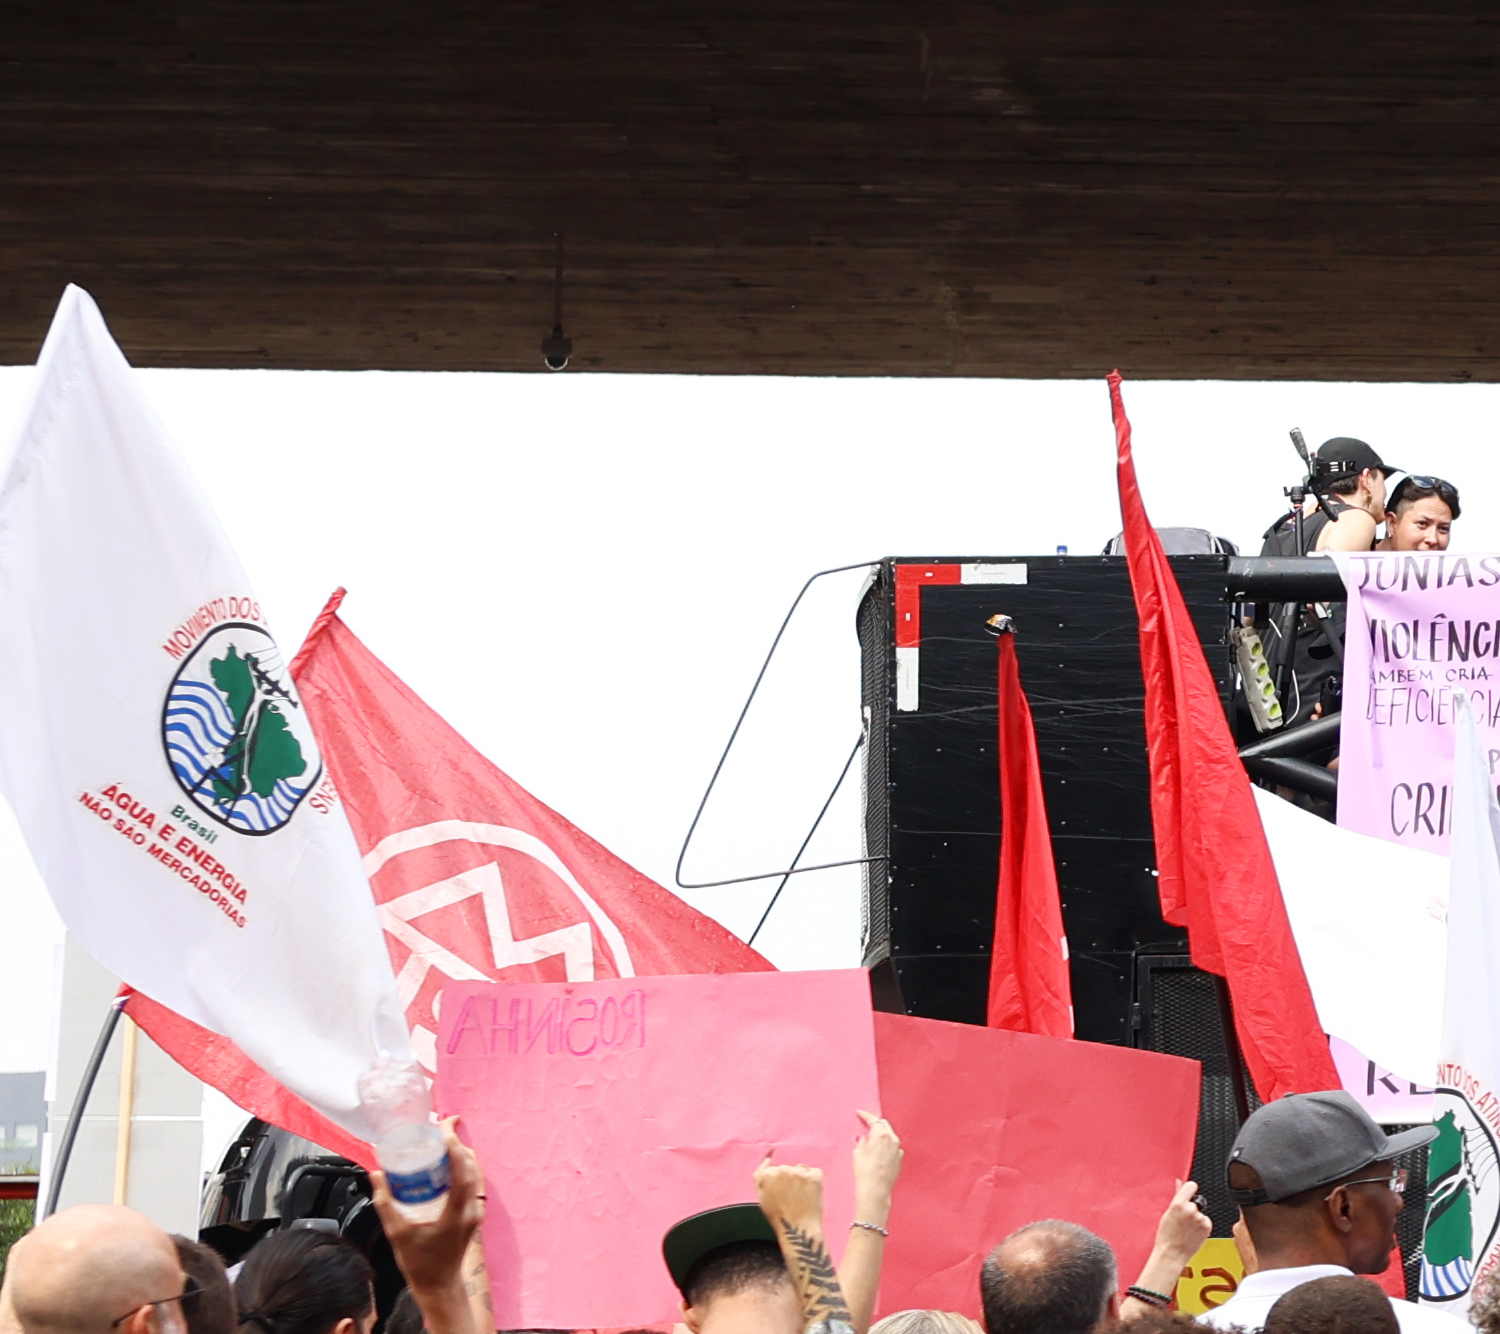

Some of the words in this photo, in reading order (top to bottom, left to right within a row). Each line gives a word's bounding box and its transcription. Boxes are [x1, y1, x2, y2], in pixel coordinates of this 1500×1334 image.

[228, 596, 261, 620] DOS
[1445, 666, 1493, 683] CRIA
[101, 781, 158, 834] ÁGUA
[157, 819, 178, 843] E
[175, 835, 249, 907] ENERGIA
[169, 803, 220, 845] Brasil
[78, 790, 114, 823] NÃO
[111, 816, 146, 848] SÃO
[145, 841, 249, 931] MERCADORIAS
